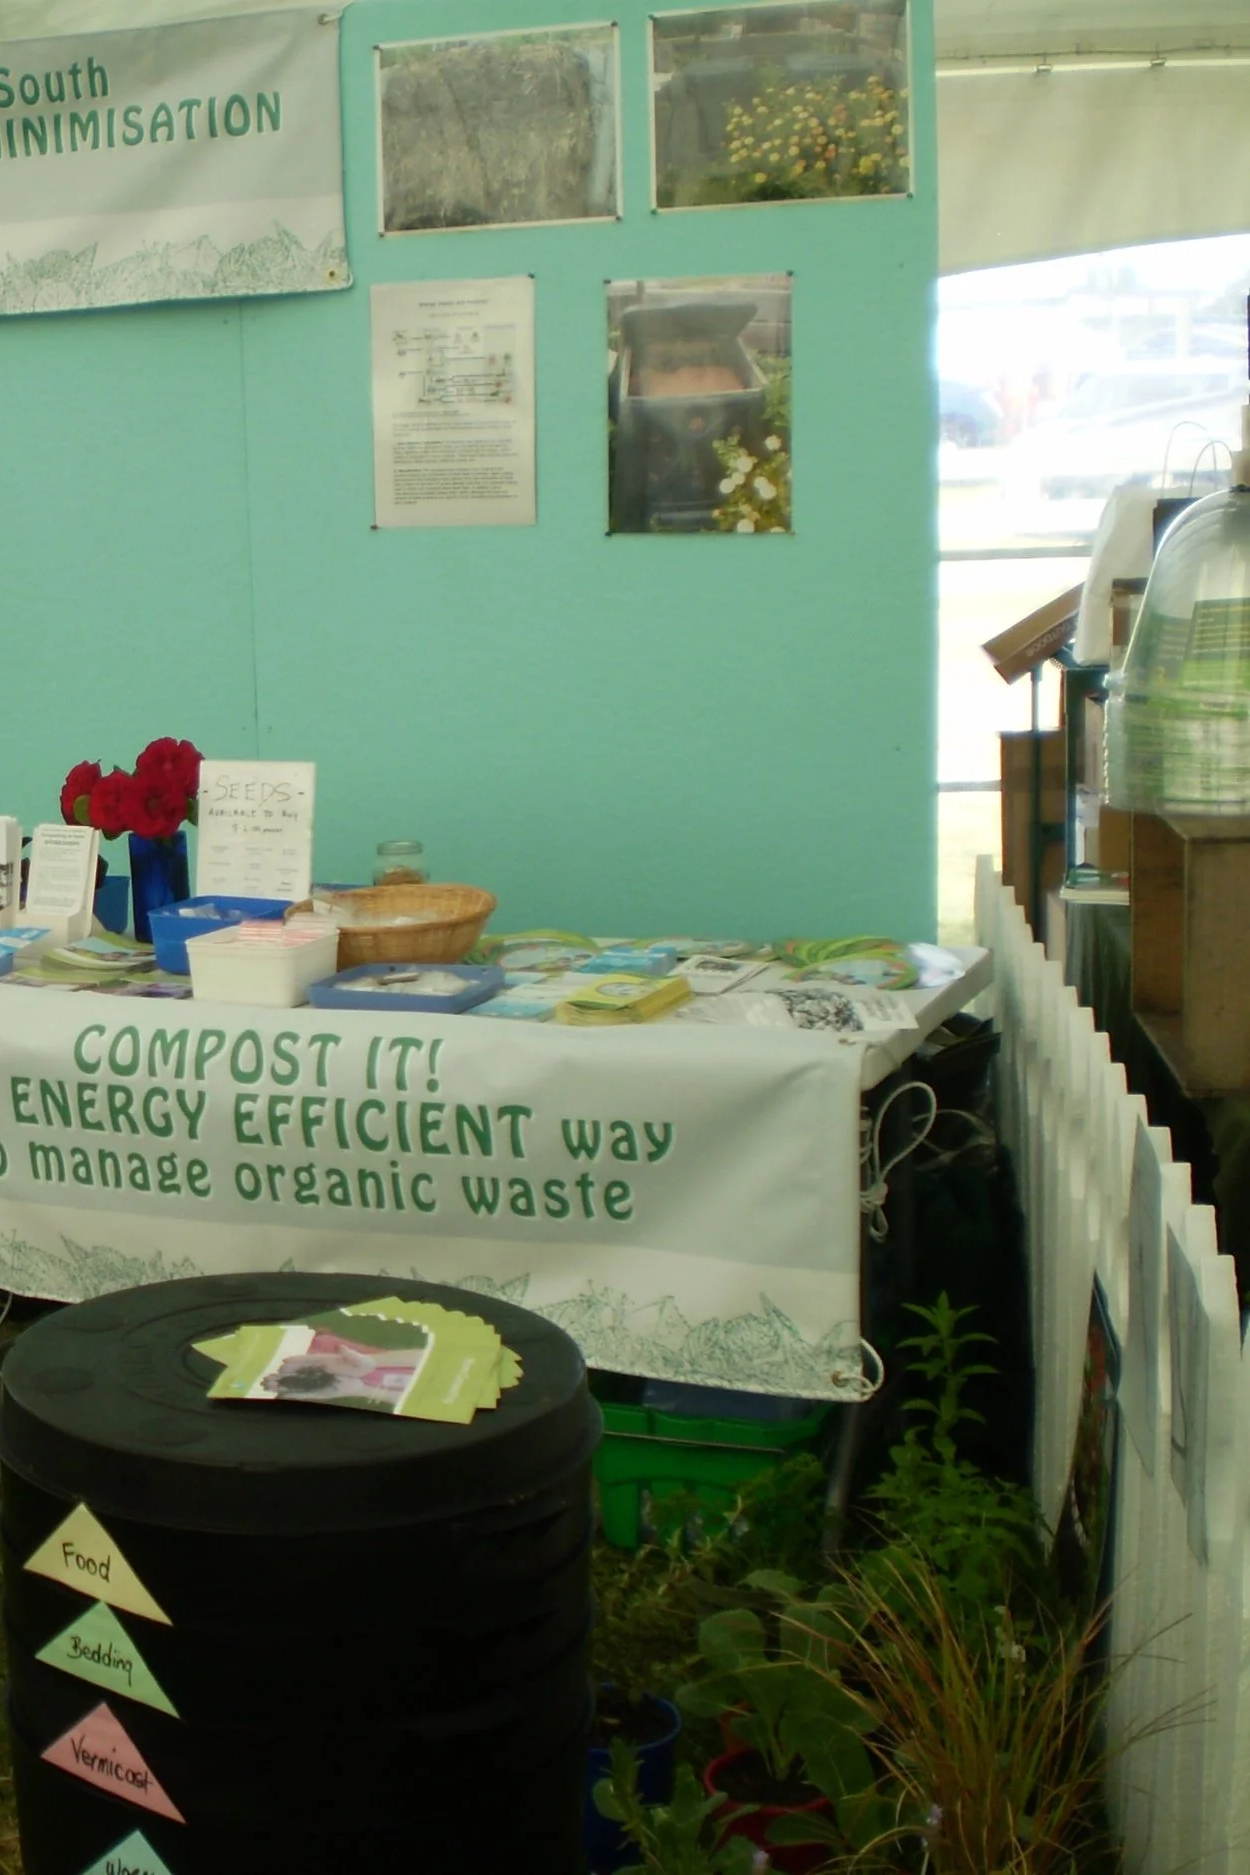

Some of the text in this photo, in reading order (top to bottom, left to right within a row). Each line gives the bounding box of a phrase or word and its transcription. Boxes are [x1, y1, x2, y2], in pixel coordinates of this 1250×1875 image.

[213, 773, 292, 807] SEEDS
[74, 1024, 447, 1093] COMPOST IT!
[10, 1074, 207, 1141] ENERGY
[232, 1091, 536, 1159] EFFICIENT
[561, 1116, 675, 1166] way
[28, 1144, 212, 1198] manage
[234, 1160, 437, 1213] organic
[461, 1173, 634, 1222] waste
[61, 1541, 111, 1583] Food
[66, 1635, 133, 1687] Bedding
